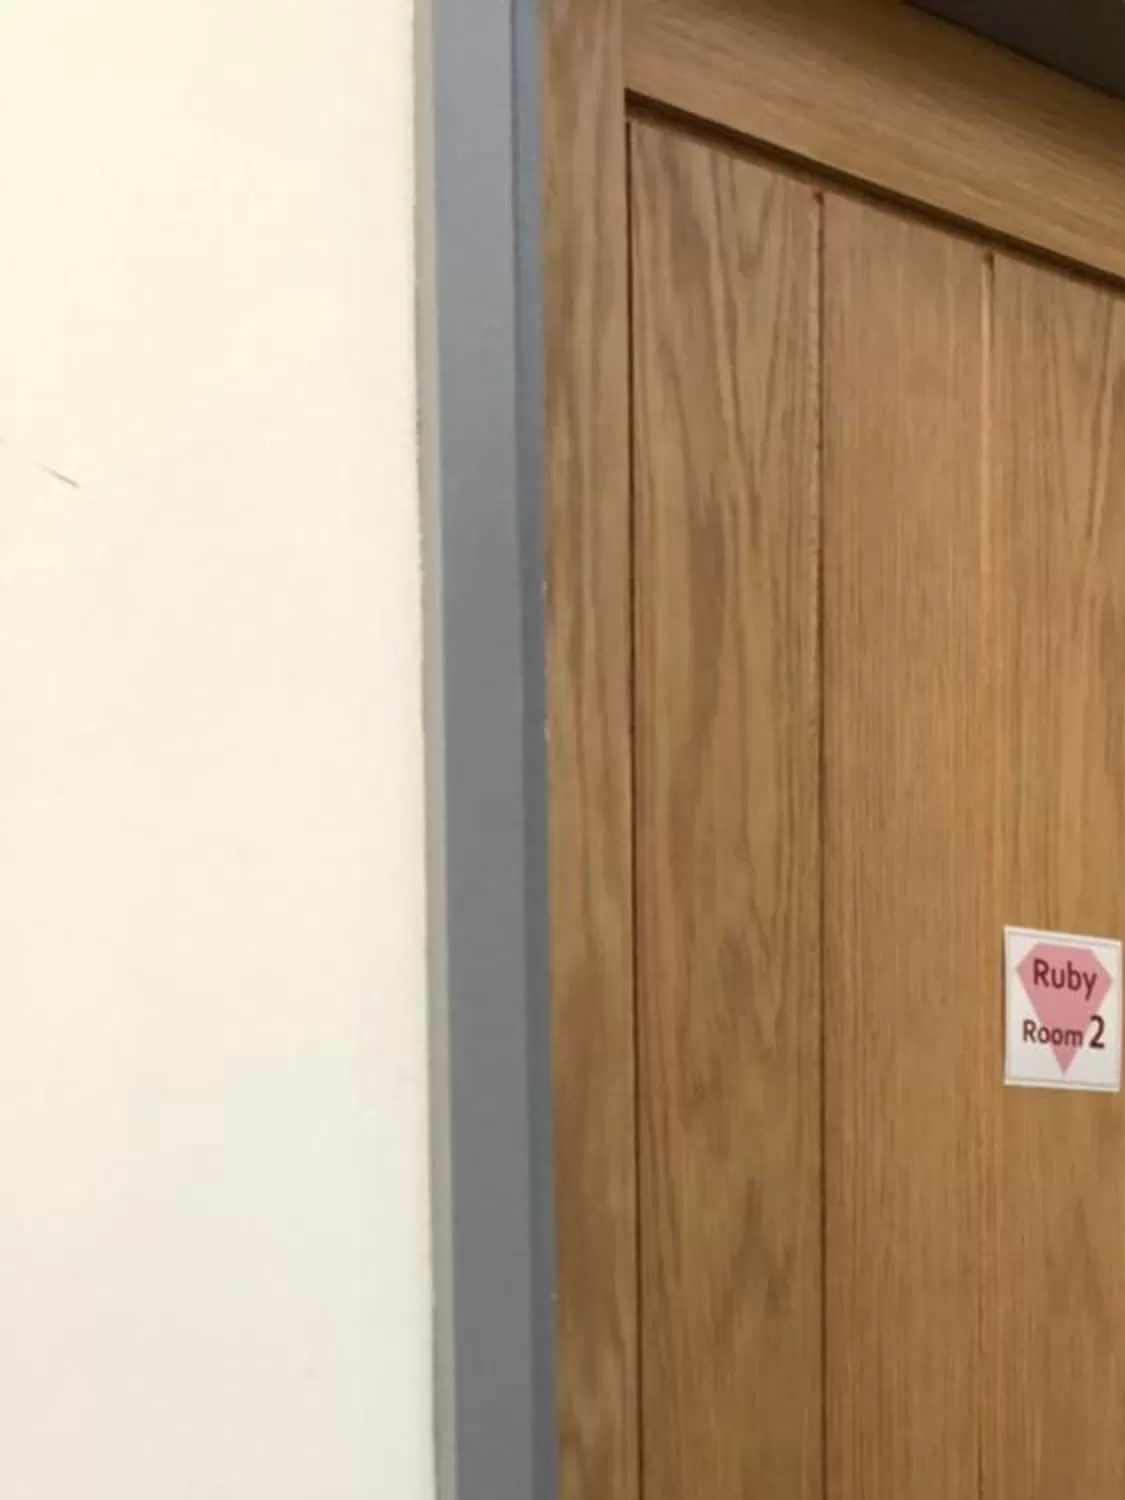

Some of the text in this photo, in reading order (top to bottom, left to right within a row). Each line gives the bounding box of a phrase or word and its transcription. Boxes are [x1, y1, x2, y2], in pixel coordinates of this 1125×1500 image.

[1033, 958, 1097, 1001] Ruby
[1022, 1014, 1105, 1049] Room 2
